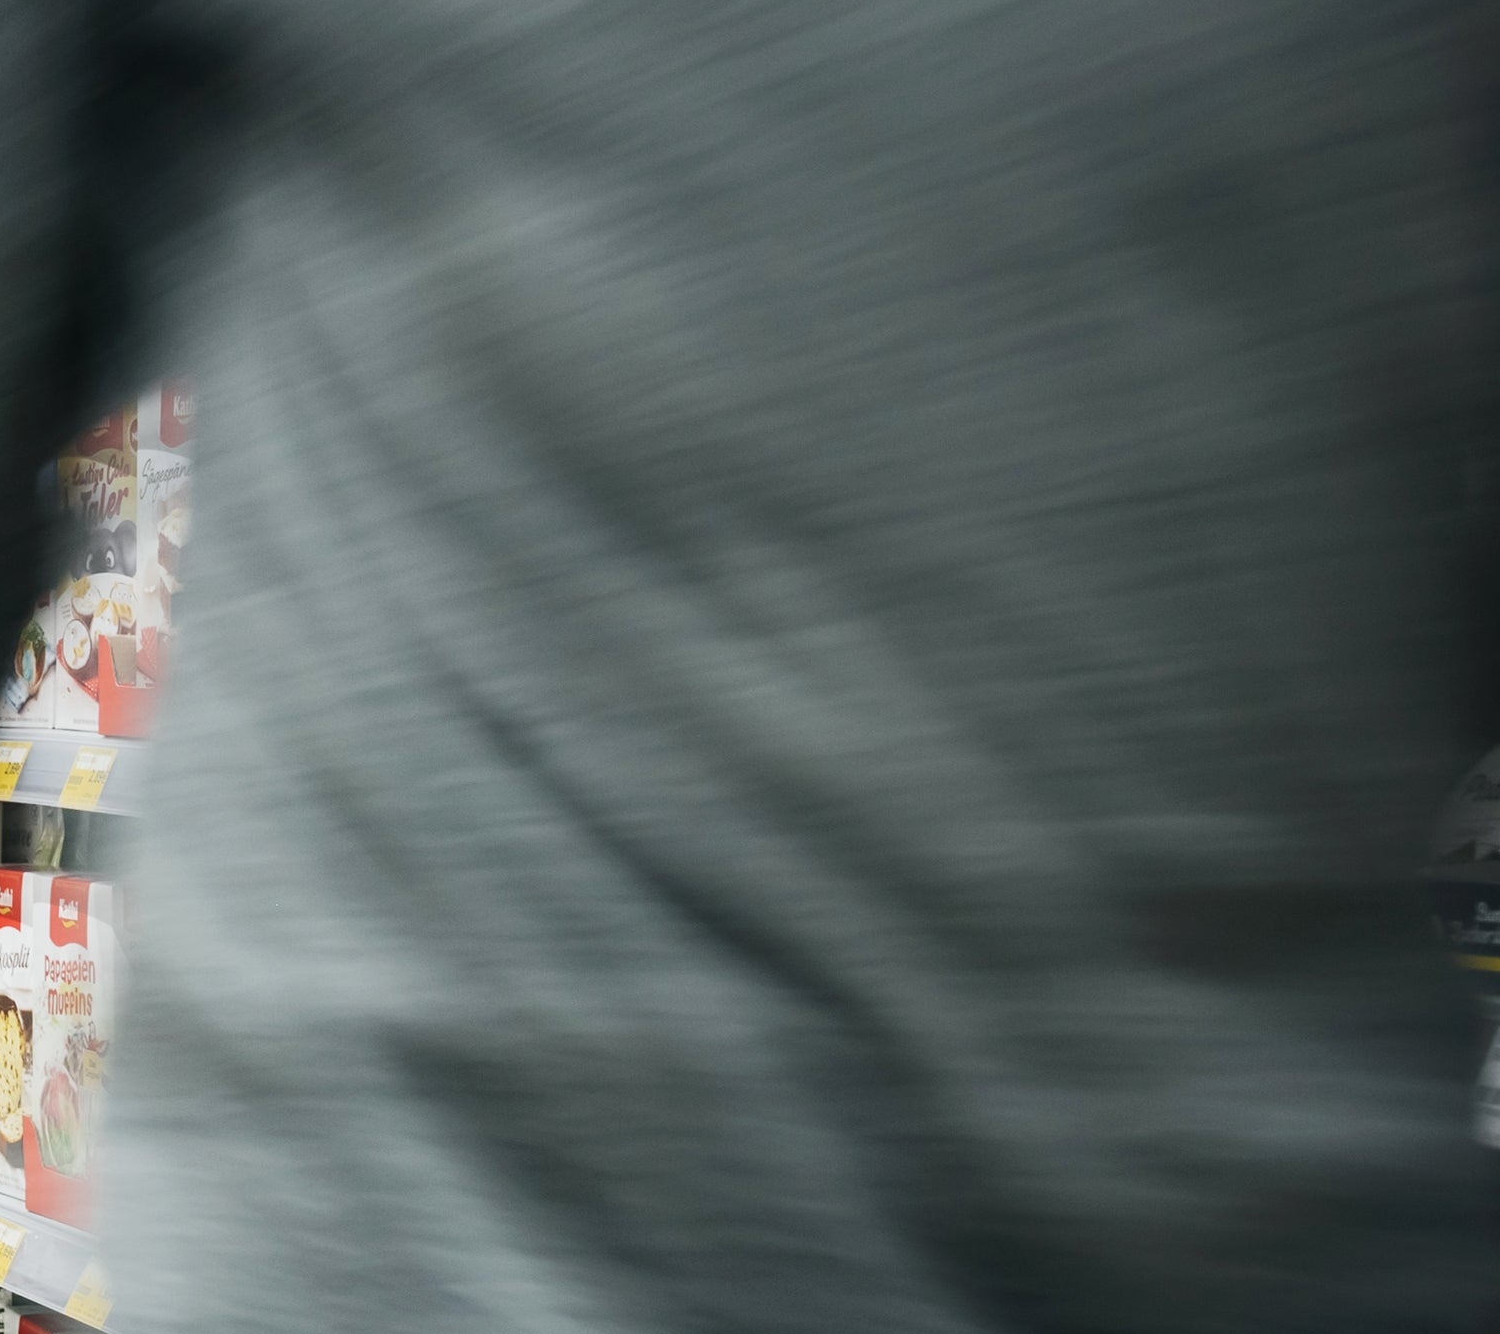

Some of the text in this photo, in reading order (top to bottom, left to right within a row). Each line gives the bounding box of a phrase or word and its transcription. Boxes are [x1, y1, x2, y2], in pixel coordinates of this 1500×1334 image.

[58, 899, 78, 920] Kathi
[43, 954, 96, 985] Papageien
[47, 988, 93, 1017] Muffins
